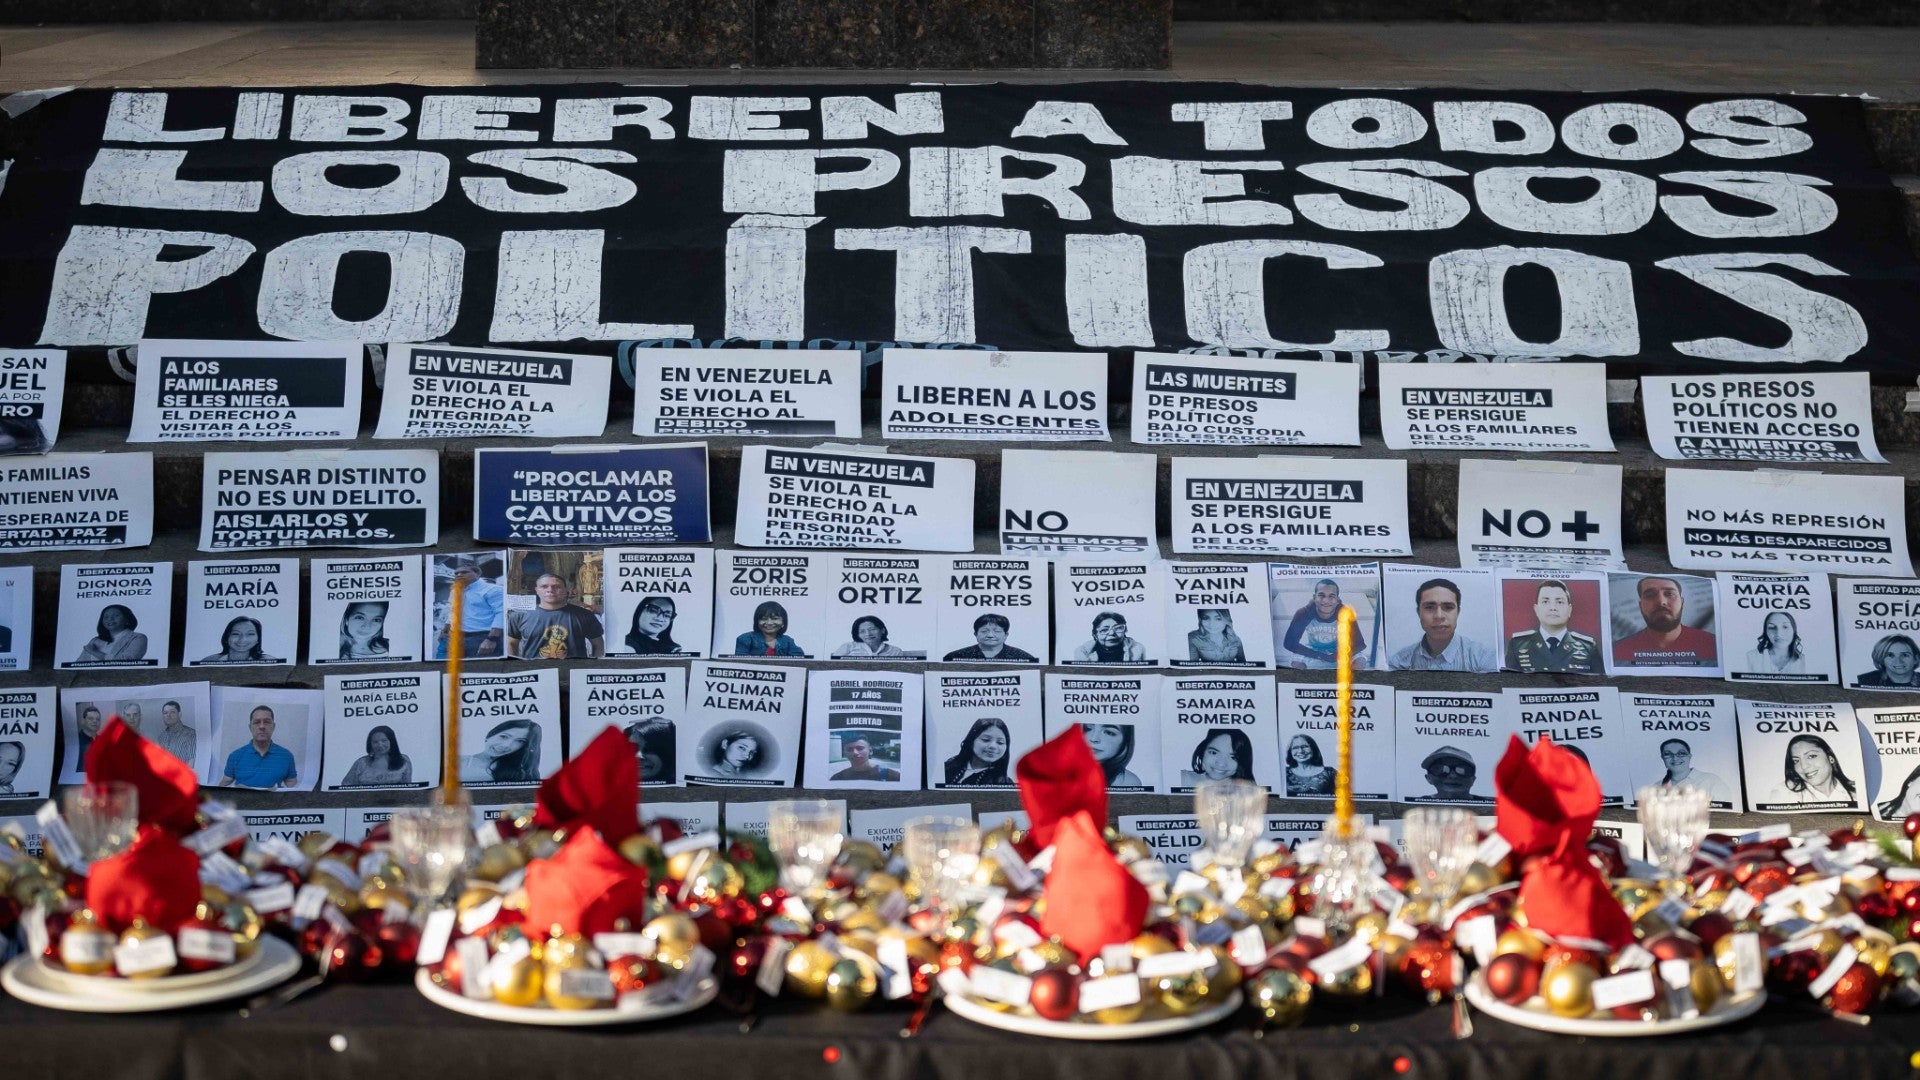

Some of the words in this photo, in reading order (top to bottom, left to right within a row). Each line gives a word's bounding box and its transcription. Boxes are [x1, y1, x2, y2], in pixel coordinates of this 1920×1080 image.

[103, 92, 944, 144] LIBEREN
[1011, 101, 1129, 146] A
[1171, 97, 1814, 161] TODOS
[80, 148, 638, 216] LOS
[723, 146, 1838, 239] PRESOS
[35, 215, 1869, 363] POLÍTICOS
[2, 358, 47, 369] SAN
[165, 362, 177, 374] A
[183, 362, 220, 374] LOS
[415, 356, 441, 371] EN
[447, 358, 564, 379] VENEZUELA
[661, 367, 690, 381] EN
[697, 368, 832, 384] VENEZUELA
[1150, 371, 1187, 387] LAS
[1193, 374, 1287, 393] MUERTES
[164, 379, 278, 391] FAMILIARES
[413, 378, 437, 391] SE
[442, 379, 502, 395] VIOLA
[508, 384, 530, 397] EL
[1671, 383, 1716, 397] LOS
[1723, 381, 1815, 398] PRESOS
[163, 395, 188, 407] SE
[192, 395, 226, 407] LES
[232, 395, 290, 407] NIEGA
[660, 388, 688, 401] SE
[694, 389, 764, 402] VIOLA
[770, 390, 797, 403] EL
[898, 385, 1010, 408] LIBEREN
[1018, 390, 1036, 408] A
[1044, 390, 1096, 411] LOS
[1407, 391, 1430, 404] EN
[1434, 391, 1546, 405] VENEZUELA
[411, 395, 505, 410] DERECHO
[512, 401, 527, 411] A
[530, 402, 554, 412] LA
[1149, 394, 1174, 407] DE
[1180, 396, 1258, 412] PRESOS
[1673, 399, 1797, 418] POLÍTICOS
[1804, 403, 1837, 418] NO
[162, 411, 184, 420] EL
[192, 411, 279, 420] DERECHO
[283, 411, 297, 419] A
[409, 409, 531, 422] INTEGRIDAD
[660, 407, 769, 418] DERECHO
[776, 408, 804, 418] AL
[1148, 409, 1254, 425] POLÍTICOS
[1407, 409, 1429, 420] SE
[1435, 409, 1526, 421] PERSIGUE
[889, 410, 1101, 429] ADOLESCENTES
[1674, 421, 1758, 435] TIENEN
[1766, 423, 1860, 437] ACCESO
[8, 466, 90, 482] FAMILIAS
[771, 456, 798, 470] EN
[803, 458, 925, 482] VENEZUELA
[218, 469, 311, 485] PENSAR
[318, 468, 426, 484] DISTINTO
[79, 488, 119, 501] VIVA
[769, 477, 794, 489] SE
[800, 479, 862, 496] VIOLA
[868, 486, 892, 499] EL
[1191, 483, 1219, 498] EN
[1224, 483, 1354, 499] VENEZUELA
[218, 491, 251, 506] NO
[258, 491, 286, 506] ES
[293, 491, 325, 505] UN
[511, 489, 610, 502] LIBERTAD
[617, 490, 631, 502] A
[638, 489, 676, 502] LOS
[505, 506, 672, 523] CAUTIVOS
[1191, 504, 1217, 517] SE
[1224, 505, 1331, 519] PERSIGUE
[215, 514, 348, 528] AISLARLOS
[353, 513, 369, 526] Y
[1005, 509, 1068, 532] NO
[1687, 510, 1715, 522] NO
[1724, 510, 1764, 524] MÁS
[1773, 513, 1885, 529] REPRESIÓN
[59, 529, 67, 537] Y
[73, 528, 107, 537] PAZ
[1191, 523, 1206, 533] A
[1212, 523, 1253, 534] LOS
[1260, 524, 1390, 536] FAMILIARES
[1008, 536, 1137, 545] TENEMOS
[1688, 533, 1712, 542] NO
[1717, 533, 1750, 543] MÁS
[1755, 535, 1888, 550] DESAPARECIDOS
[1732, 551, 1778, 560] MÁS
[1786, 554, 1892, 564] TORTURA
[619, 567, 692, 577] DANIELA
[732, 568, 807, 584] ZORIS
[842, 572, 919, 583] XIOMARA
[78, 578, 152, 589] DIGNORA
[206, 579, 278, 596] MARÍA
[327, 576, 401, 589] GÉNESIS
[620, 579, 691, 593] ARAÑA
[950, 576, 1032, 590] MERYS
[1072, 579, 1145, 592] YOSIDA
[1175, 578, 1246, 590] YANIN
[1734, 583, 1810, 595] MARÍA
[77, 588, 152, 599] HERNÁNDEZ
[327, 590, 402, 600] RODRÍGUEZ
[730, 585, 808, 596] GUTIÉRREZ
[838, 587, 922, 604] ORTIZ
[204, 599, 279, 609] DELGADO
[950, 594, 1032, 606] TORRES
[1074, 594, 1145, 606] VANEGAS
[1175, 591, 1249, 605] PERNÍA
[1738, 598, 1811, 609] CUICAS
[341, 679, 389, 688] LIBERTAD
[942, 678, 988, 686] LIBERTAD
[461, 687, 537, 703] CARLA
[588, 688, 665, 701] ÁNGELA
[705, 681, 784, 698] YOLIMAR
[862, 691, 881, 699] AÑOS
[942, 688, 1020, 697] SAMANTHA
[344, 693, 382, 704] MARÍA
[386, 692, 417, 701] ELBA
[703, 696, 781, 713] ALEMÁN
[943, 698, 1021, 707] HERNÁNDEZ
[1064, 694, 1138, 702] FRANMARY
[1176, 699, 1255, 709] SAMAIRA
[1413, 698, 1460, 706] LIBERTAD
[344, 703, 418, 717] DELGADO
[462, 707, 486, 718] DA
[490, 703, 540, 716] SILVA
[588, 703, 664, 716] EXPÓSITO
[1064, 705, 1140, 714] QUINTERO
[1521, 709, 1602, 723] RANDAL
[1639, 710, 1712, 719] CATALINA
[1755, 711, 1836, 719] JENNIFER
[1178, 713, 1256, 725] ROMERO
[1416, 713, 1489, 724] LOURDES
[1415, 727, 1490, 737] VILLARREAL
[1642, 721, 1711, 731] RAMOS
[1756, 721, 1839, 733] OZUNA
[1524, 726, 1604, 743] TELLES
